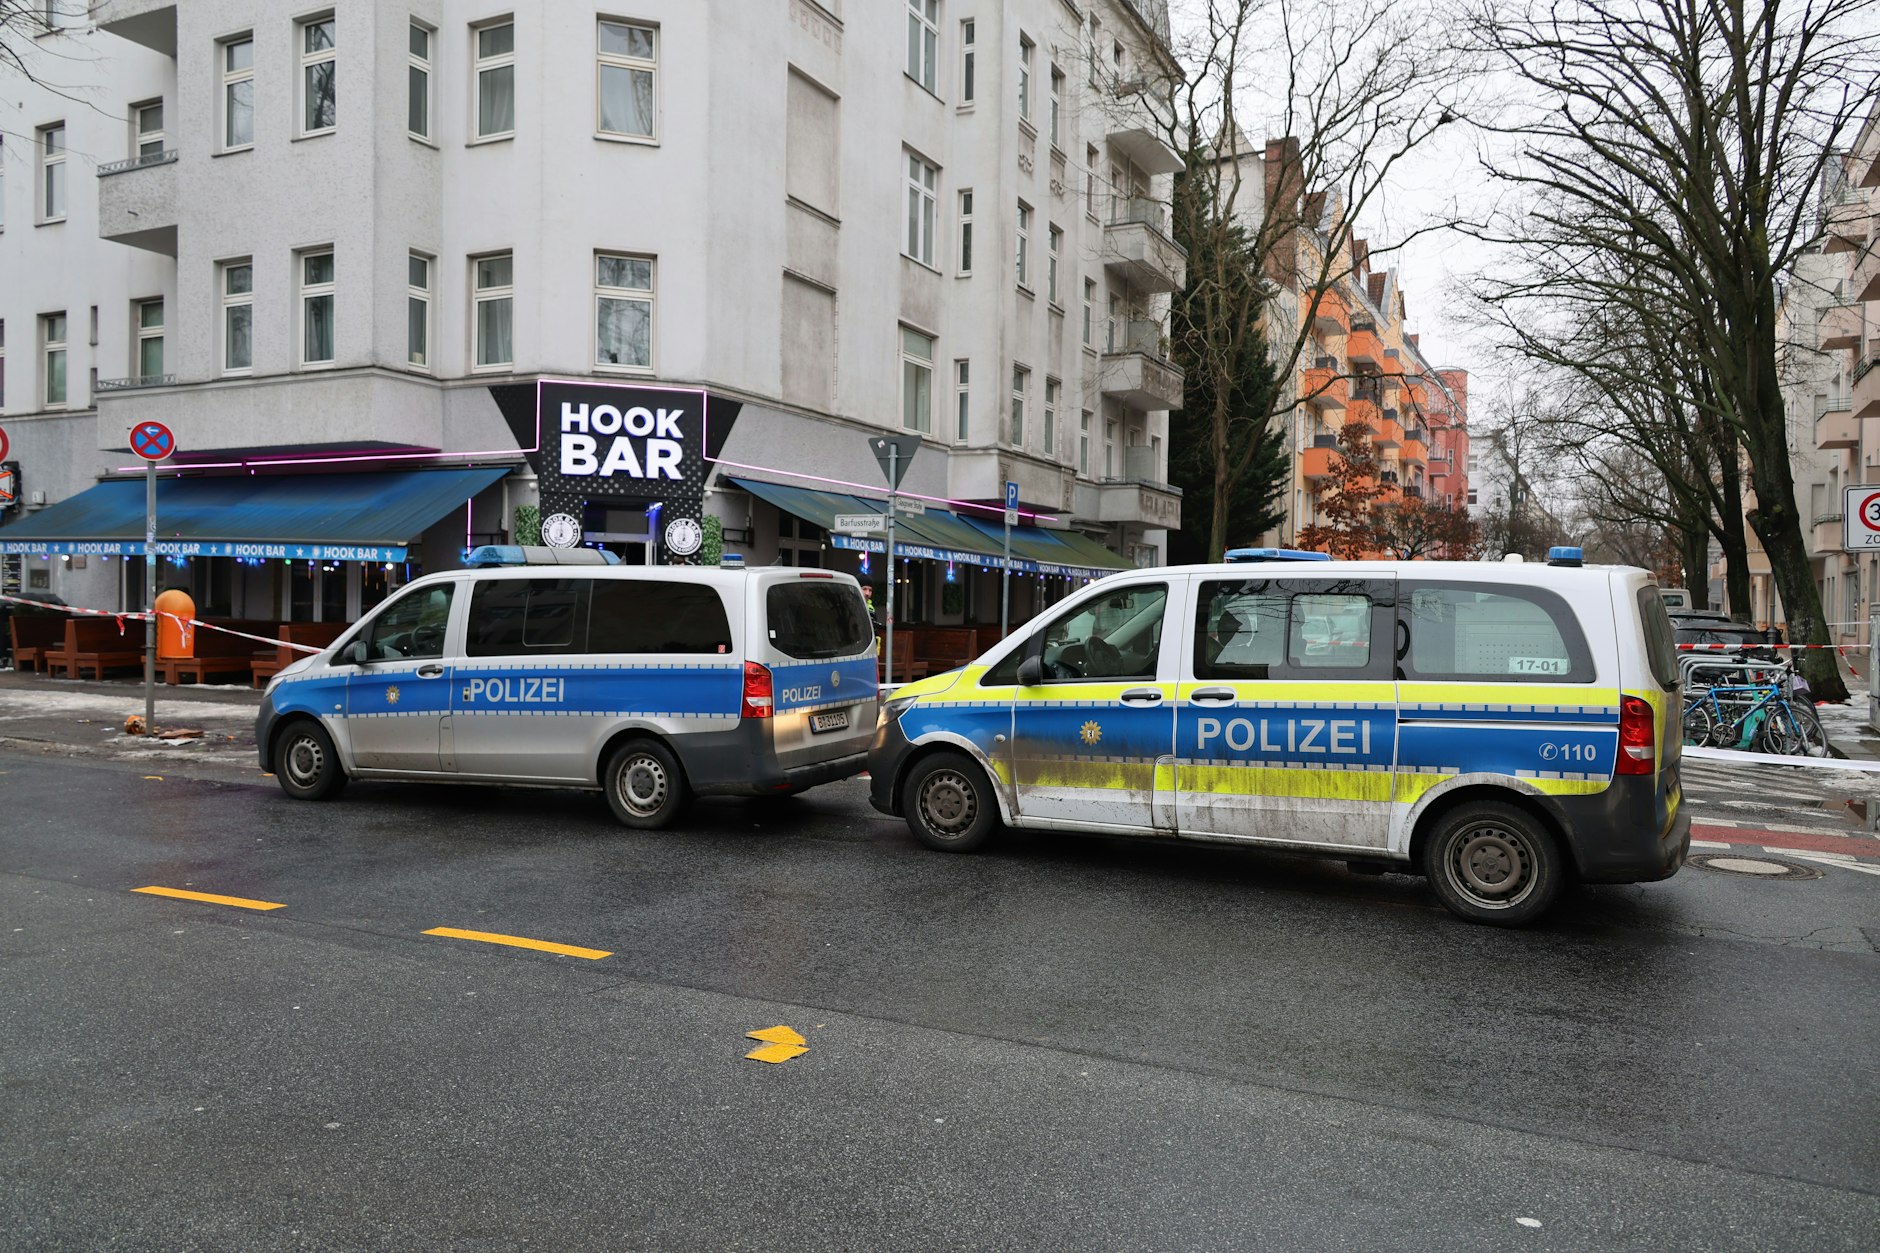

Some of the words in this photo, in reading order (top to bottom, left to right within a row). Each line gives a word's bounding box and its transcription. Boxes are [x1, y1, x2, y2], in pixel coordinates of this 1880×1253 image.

[561, 402, 684, 438] HOOK
[560, 433, 684, 480] BAR
[1008, 485, 1016, 506] P
[840, 519, 880, 528] Barfusstraße
[7, 543, 31, 553] HOOK
[32, 543, 47, 553] BAR
[78, 544, 103, 553] HOOK
[104, 544, 121, 554] BAR
[182, 544, 200, 555] BAR
[236, 544, 264, 556] HOOK
[266, 545, 285, 557] BAR
[850, 538, 869, 550] HOOK
[870, 541, 883, 552] BAR
[905, 546, 922, 556] HOOK
[922, 548, 933, 557] BAR
[323, 547, 355, 559] HOOK
[357, 548, 378, 560] BAR
[953, 552, 970, 561] HOOK
[970, 554, 980, 564] BAR
[1517, 659, 1559, 672] 17-01
[470, 678, 564, 702] POLIZEI
[782, 685, 822, 703] POLIZEI
[1197, 717, 1371, 754] POLIZEI
[1561, 743, 1597, 761] 110
